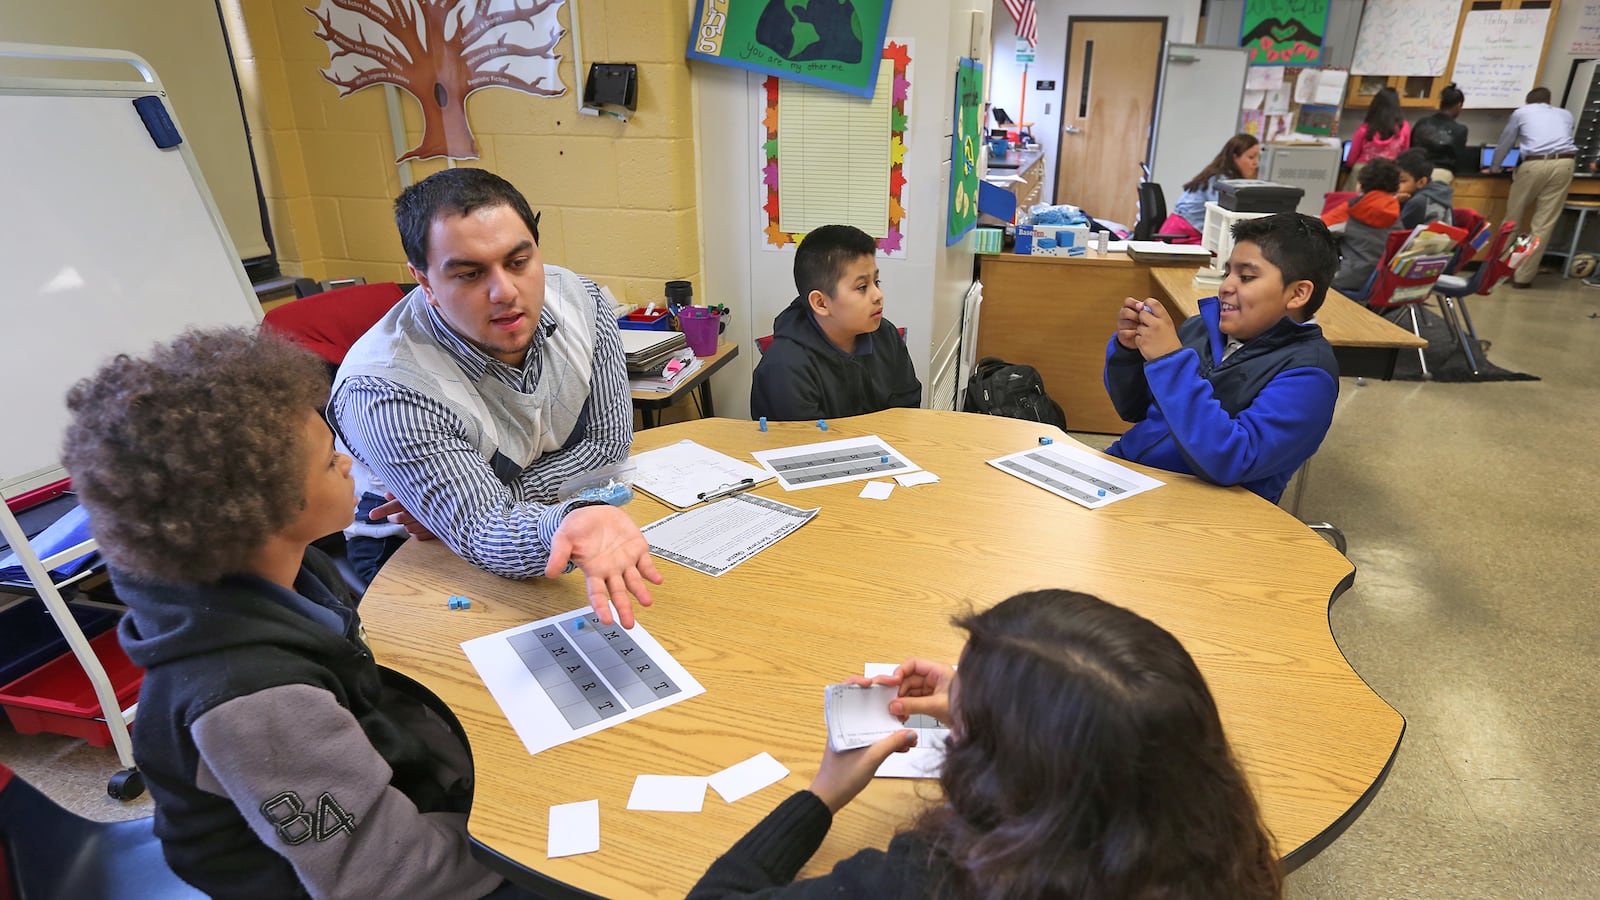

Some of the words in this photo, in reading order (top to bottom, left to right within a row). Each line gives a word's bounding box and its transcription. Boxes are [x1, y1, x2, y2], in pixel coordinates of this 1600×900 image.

[368, 7, 388, 24] Fantasy
[489, 47, 508, 55] Fiction
[768, 56, 783, 66] are
[791, 63, 802, 73] my
[807, 62, 827, 71] other
[490, 75, 510, 84] Fiction
[260, 791, 356, 846] 84
